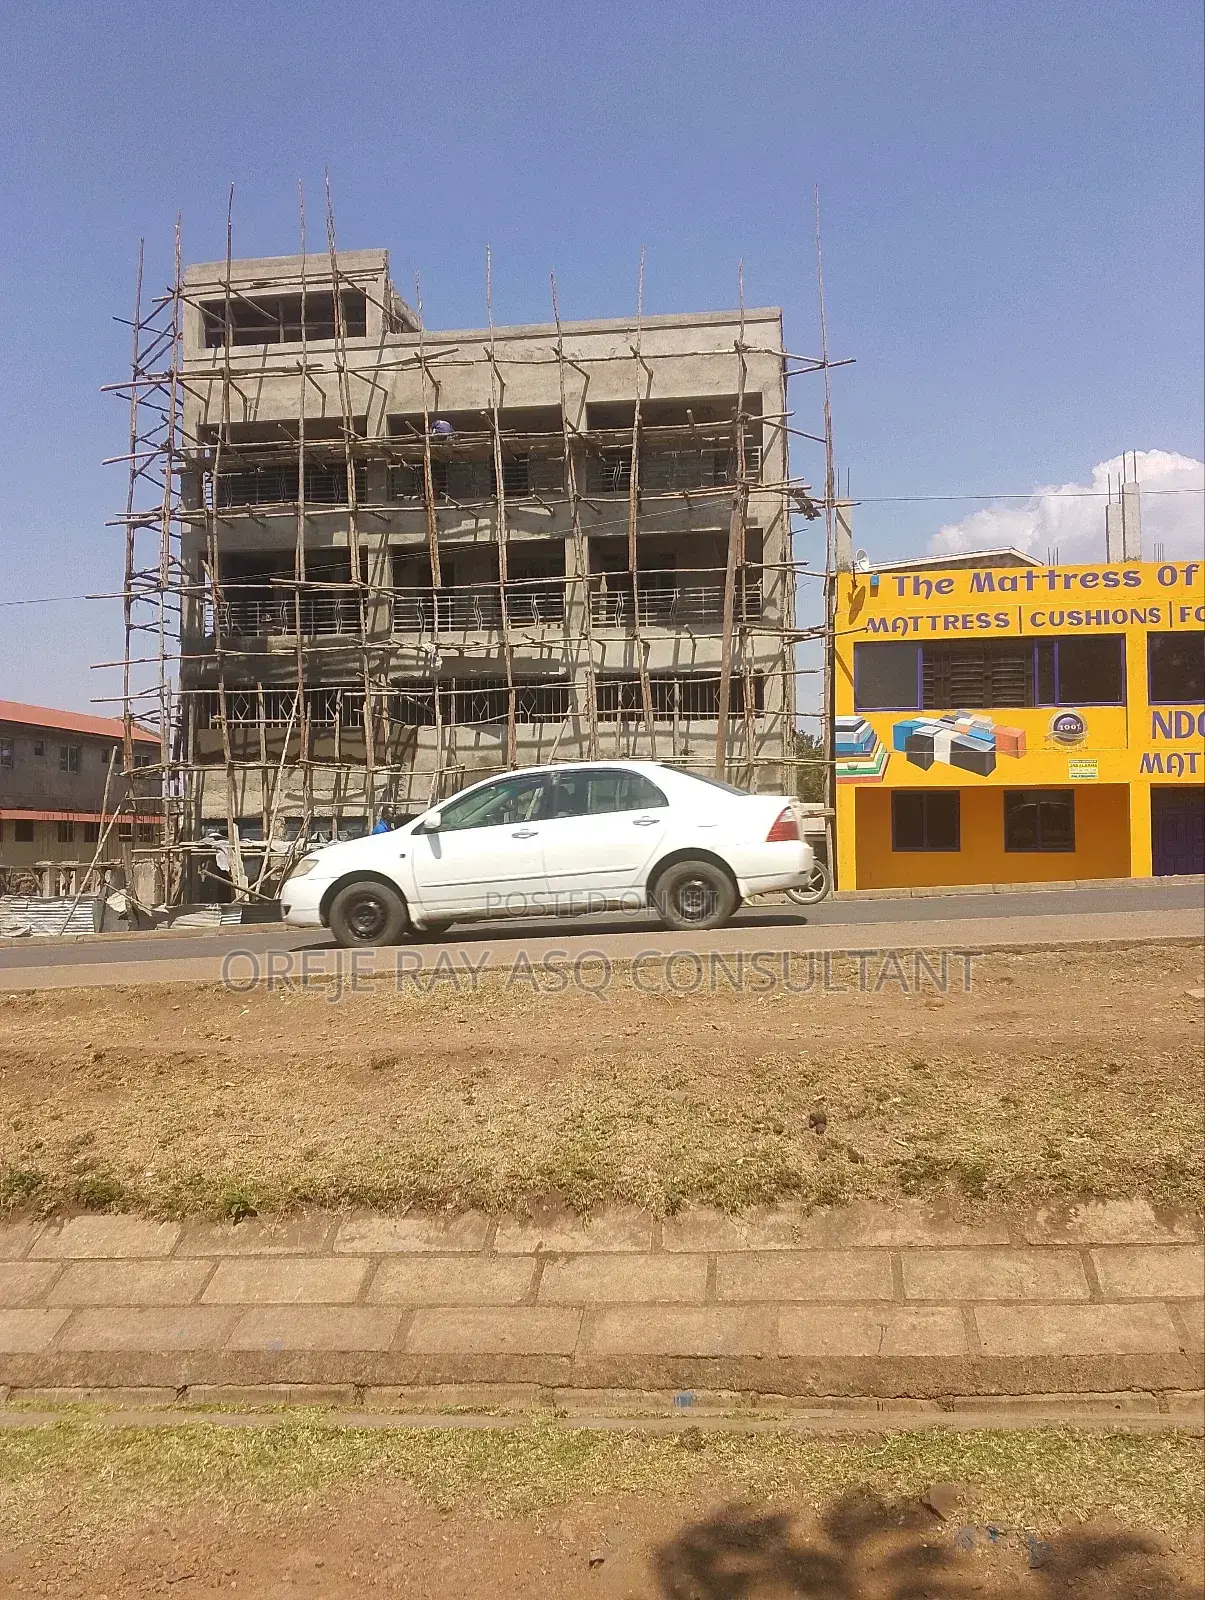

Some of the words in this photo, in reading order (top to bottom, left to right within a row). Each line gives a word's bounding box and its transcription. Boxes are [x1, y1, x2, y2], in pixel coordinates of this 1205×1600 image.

[892, 575, 955, 600] The
[969, 569, 1142, 593] Mattress
[1157, 563, 1200, 586] Of
[866, 612, 1010, 636] MATTRESS
[1030, 607, 1162, 627] CUSHIONS
